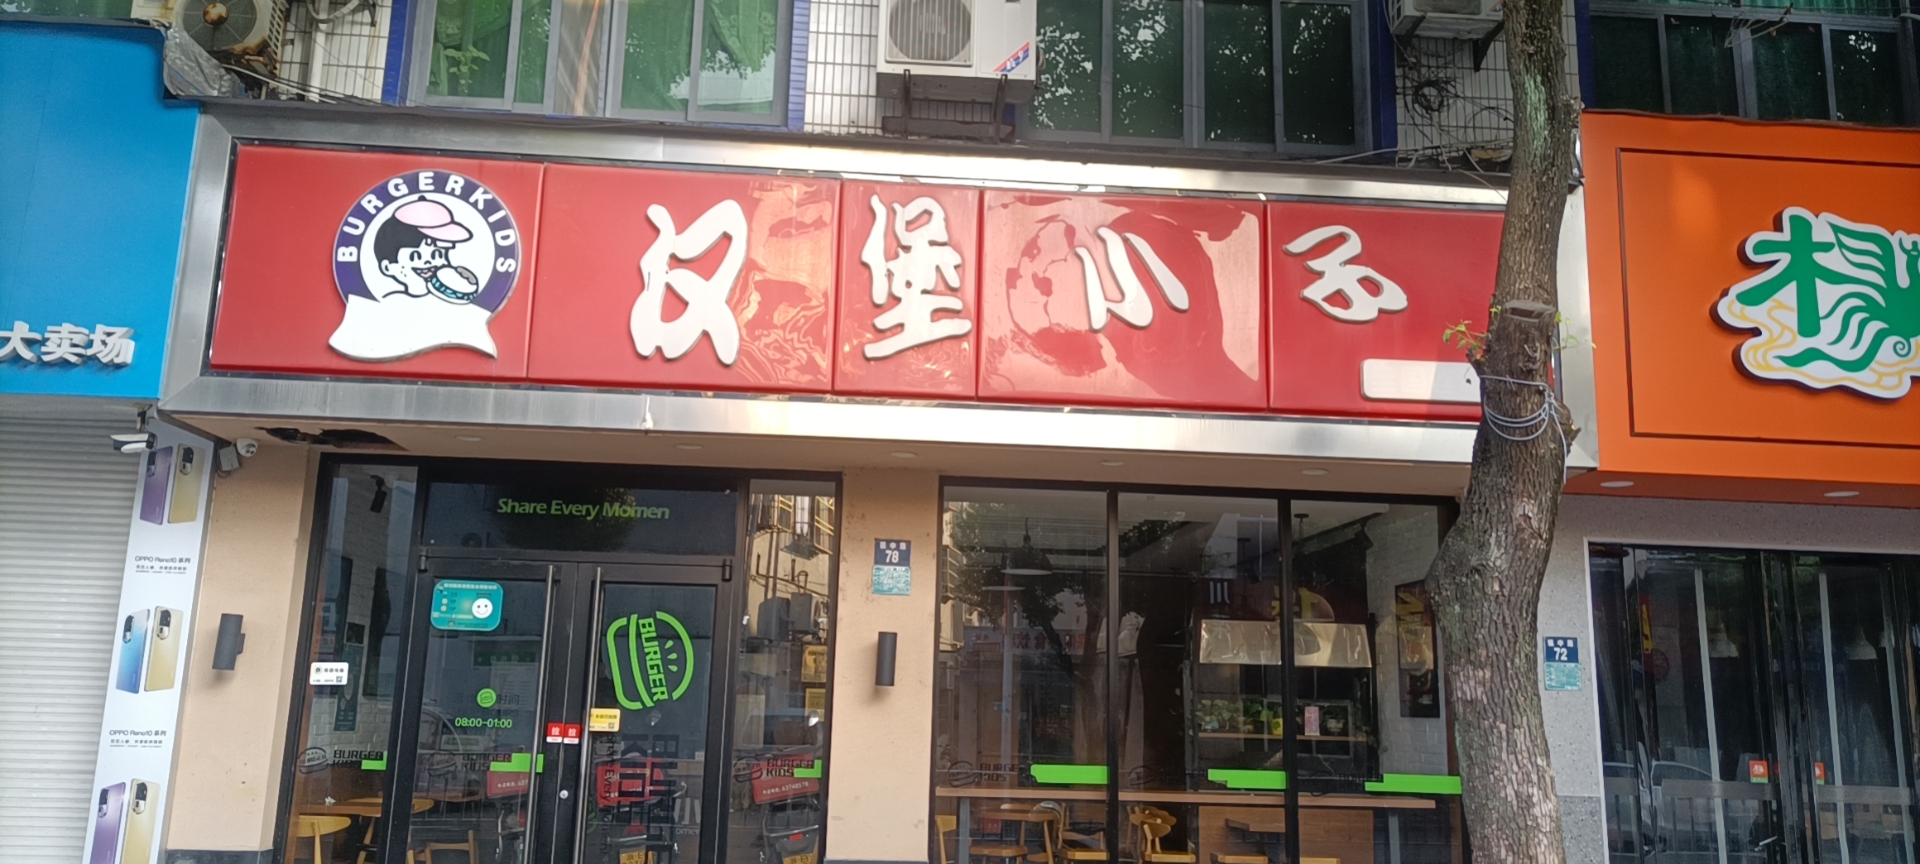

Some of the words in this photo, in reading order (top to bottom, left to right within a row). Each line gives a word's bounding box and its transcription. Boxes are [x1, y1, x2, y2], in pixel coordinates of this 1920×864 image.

[337, 170, 517, 275] BURGERKIDS
[0, 320, 136, 366] 大卖场
[497, 498, 547, 514] Share
[550, 499, 602, 520] Every
[602, 502, 670, 520] Momen
[885, 550, 899, 563] 78
[637, 617, 669, 703] BURGER
[1554, 647, 1568, 661] 72
[454, 716, 513, 729] 08:00-01:00
[333, 749, 384, 761] BURGER
[979, 763, 1020, 772] BURGE
